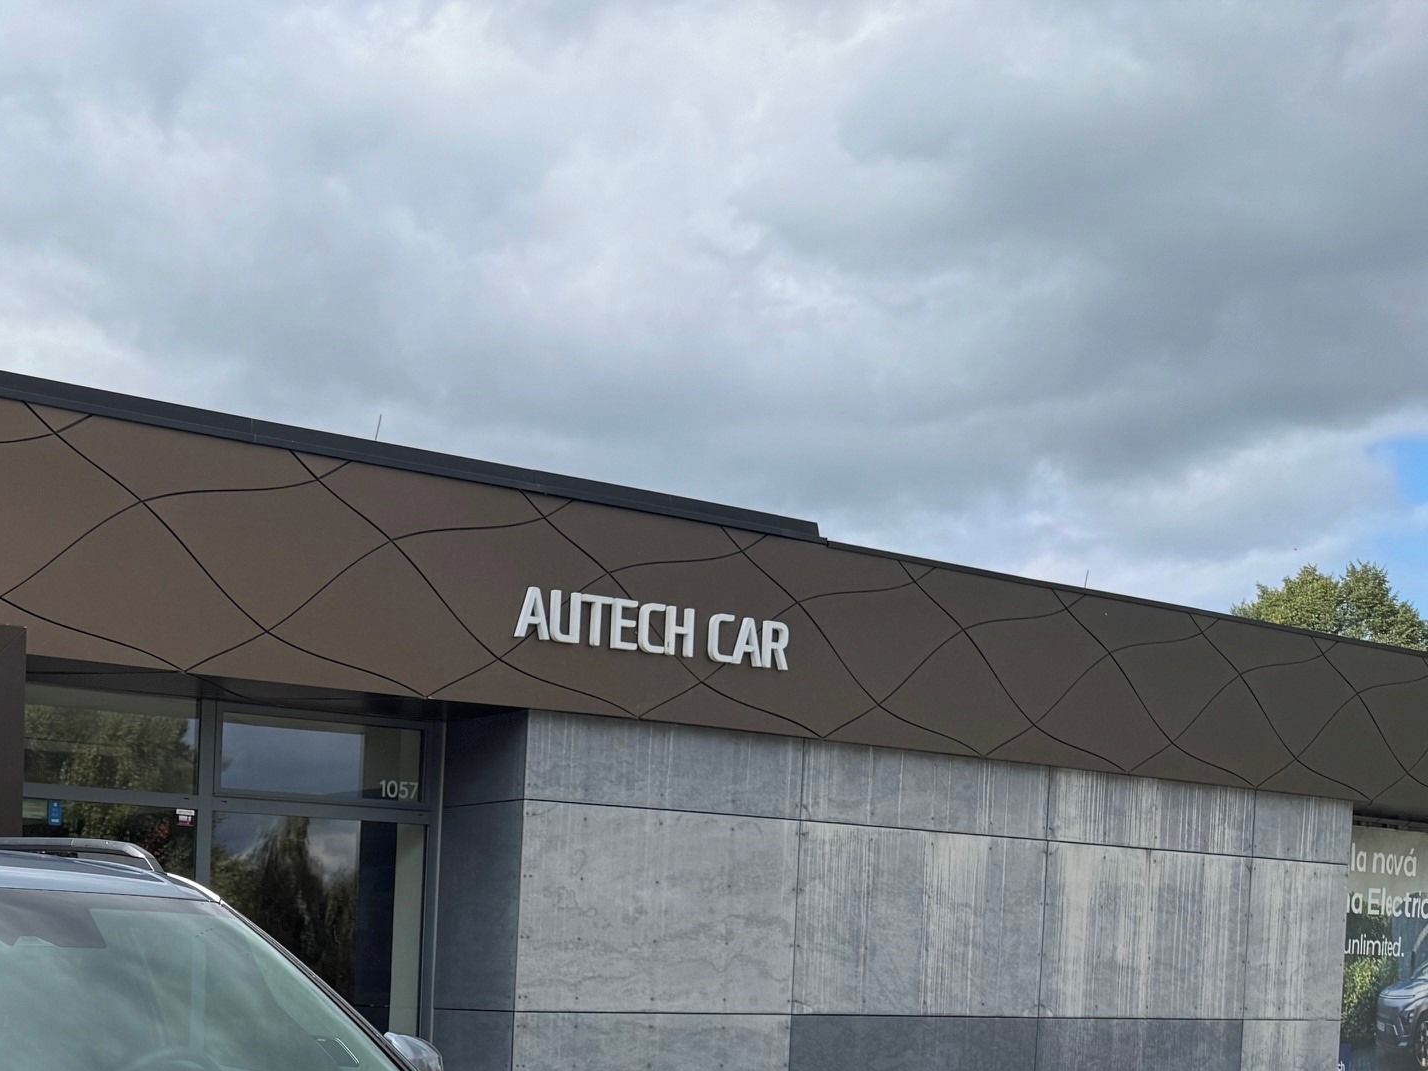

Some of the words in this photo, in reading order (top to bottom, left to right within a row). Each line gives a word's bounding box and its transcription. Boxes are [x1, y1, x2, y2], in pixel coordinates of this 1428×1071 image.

[513, 586, 695, 658] AUTECH
[707, 613, 790, 671] CAR
[379, 779, 419, 800] 1057
[1372, 847, 1418, 877] nová
